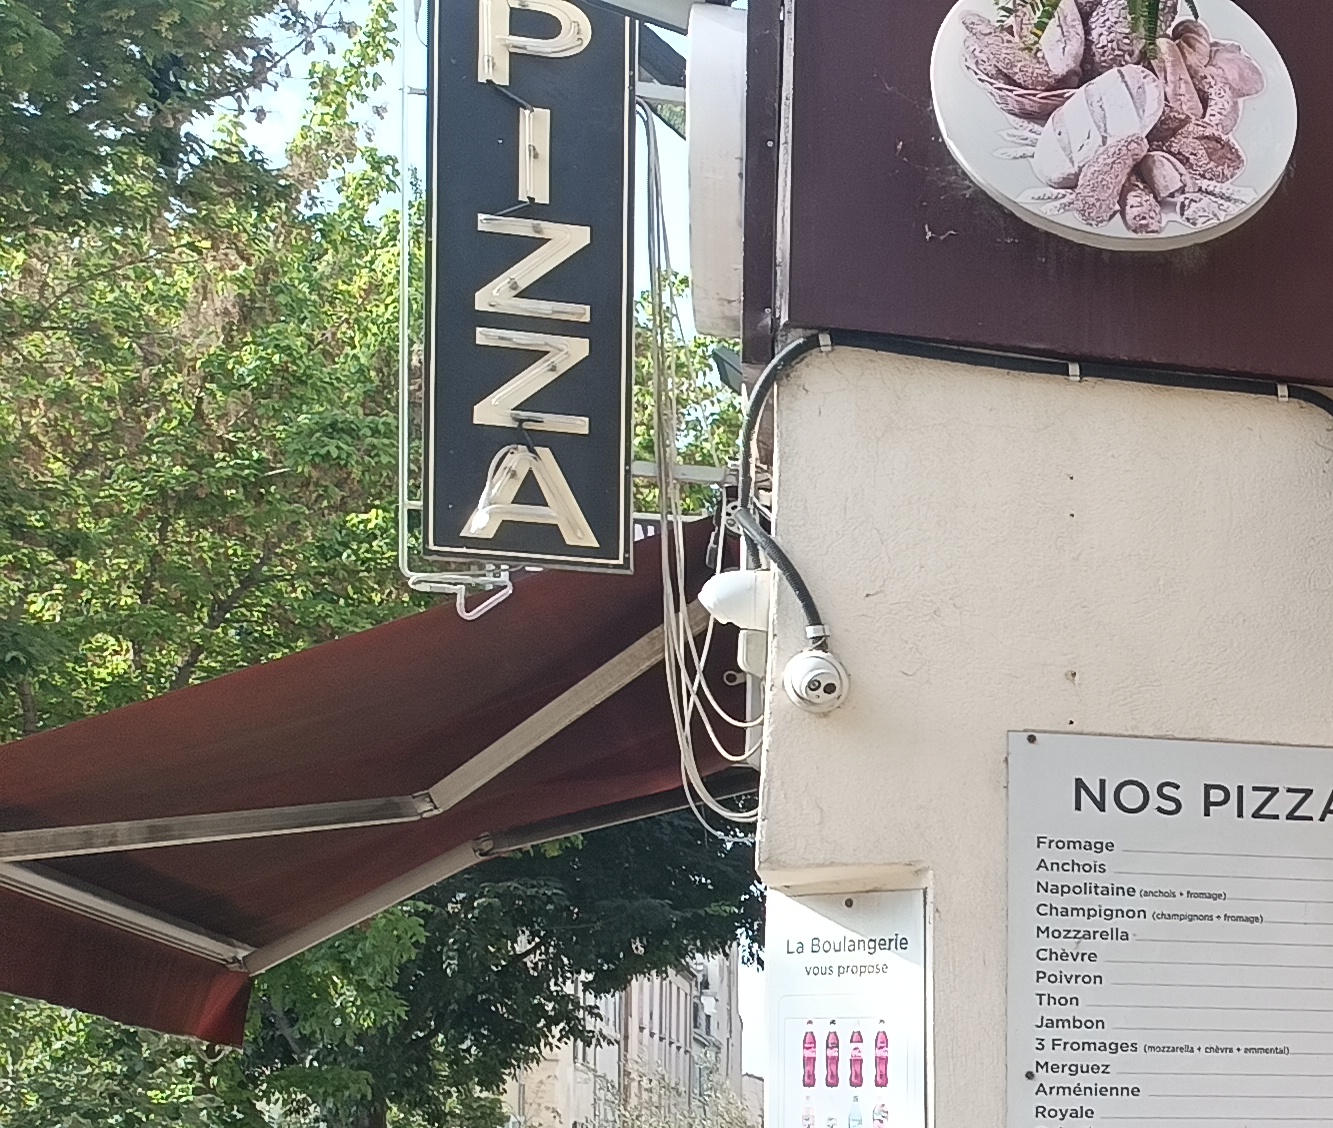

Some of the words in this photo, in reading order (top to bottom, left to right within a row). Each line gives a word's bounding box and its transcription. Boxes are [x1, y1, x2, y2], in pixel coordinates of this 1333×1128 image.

[460, 0, 600, 548] PIZZA
[1073, 777, 1183, 816] NOS
[1036, 836, 1115, 853] Fromage
[1036, 859, 1106, 874] Anchois
[1036, 881, 1136, 897] Napolitaine
[1140, 889, 1176, 898] (anchois
[1186, 890, 1227, 901] fromage)
[1036, 903, 1147, 921] Champignon
[1152, 911, 1213, 922] (champignons
[1224, 914, 1263, 924] fromage)
[1036, 926, 1129, 941] Mozzarella
[786, 939, 804, 955] La
[811, 933, 909, 955] Boulangerie
[1036, 948, 1098, 962] Chèvre
[805, 965, 834, 976] vous
[837, 963, 889, 977] propose
[1036, 970, 1103, 985] Poivron
[1035, 993, 1079, 1007] Thon
[1035, 1016, 1105, 1030] Jambon
[1035, 1038, 1045, 1051] 3
[1051, 1039, 1138, 1054] Fromages
[1144, 1044, 1194, 1054] (mozzarella
[1035, 1061, 1111, 1076] Merguez
[1035, 1083, 1141, 1098] Arménienne
[1035, 1106, 1094, 1120] Royale
